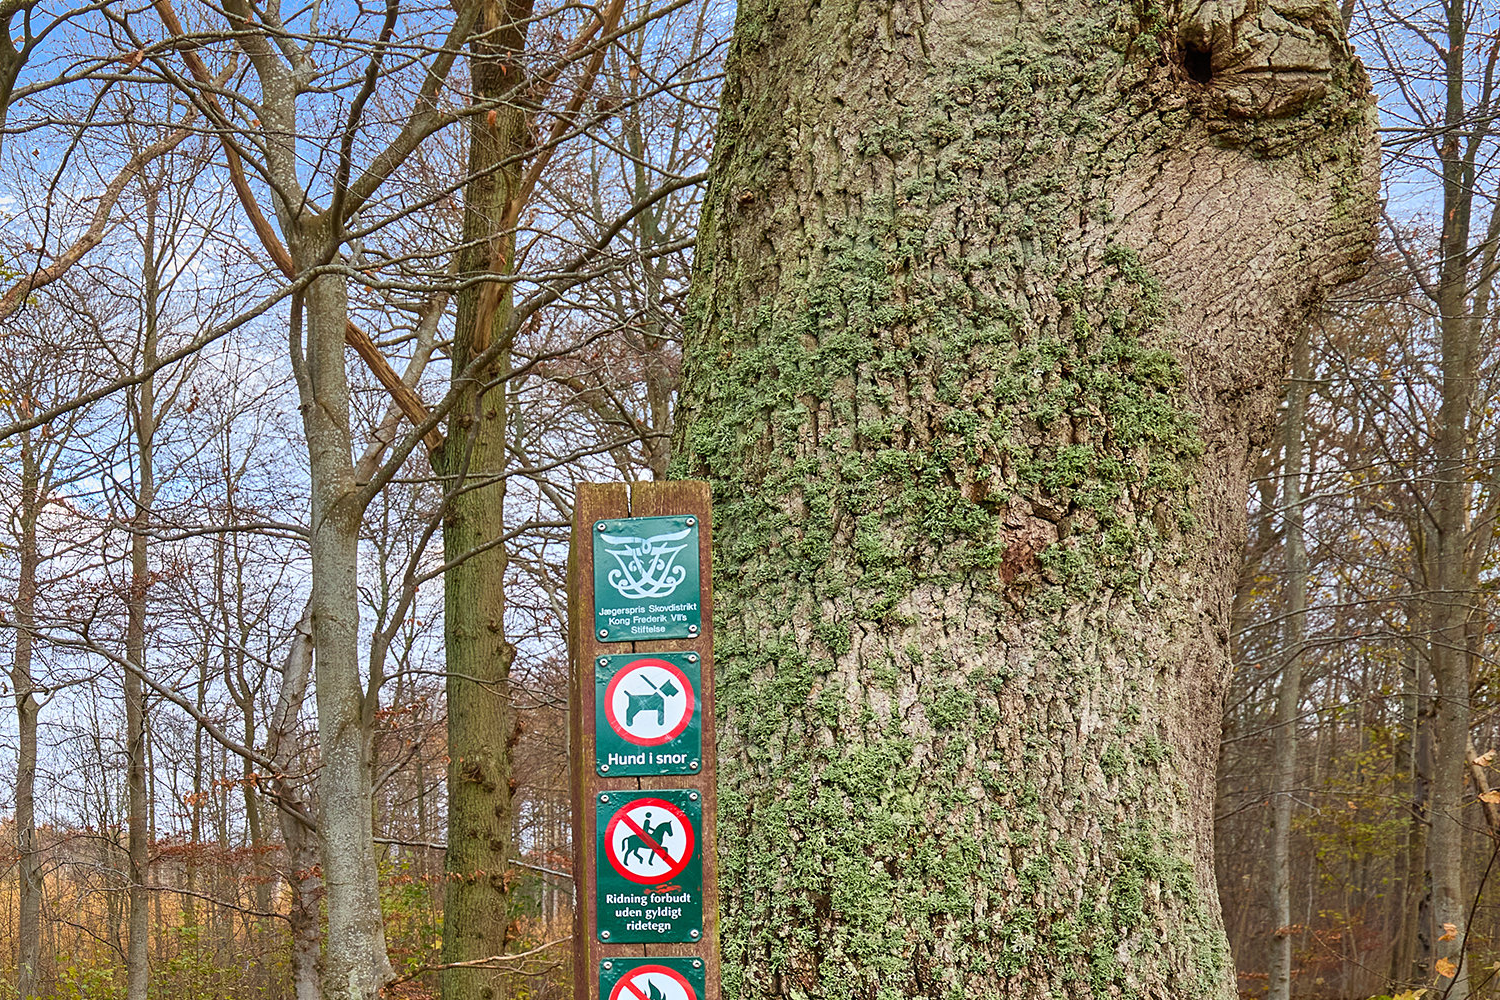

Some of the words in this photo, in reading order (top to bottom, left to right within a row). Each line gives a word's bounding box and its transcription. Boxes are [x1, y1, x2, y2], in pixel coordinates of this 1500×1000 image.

[599, 605, 645, 616] Jægerspris
[648, 603, 697, 612] Skovdistrikt
[608, 617, 631, 626] Kong
[633, 614, 668, 624] Frederik
[630, 625, 666, 634] Stiftelse
[608, 752, 646, 766] Hund
[656, 754, 688, 764] snor
[606, 893, 648, 906] Ridning
[650, 892, 691, 903] forbudt
[615, 906, 642, 917] uden
[645, 906, 682, 920] gyldigt
[626, 920, 671, 933] ridetegn
